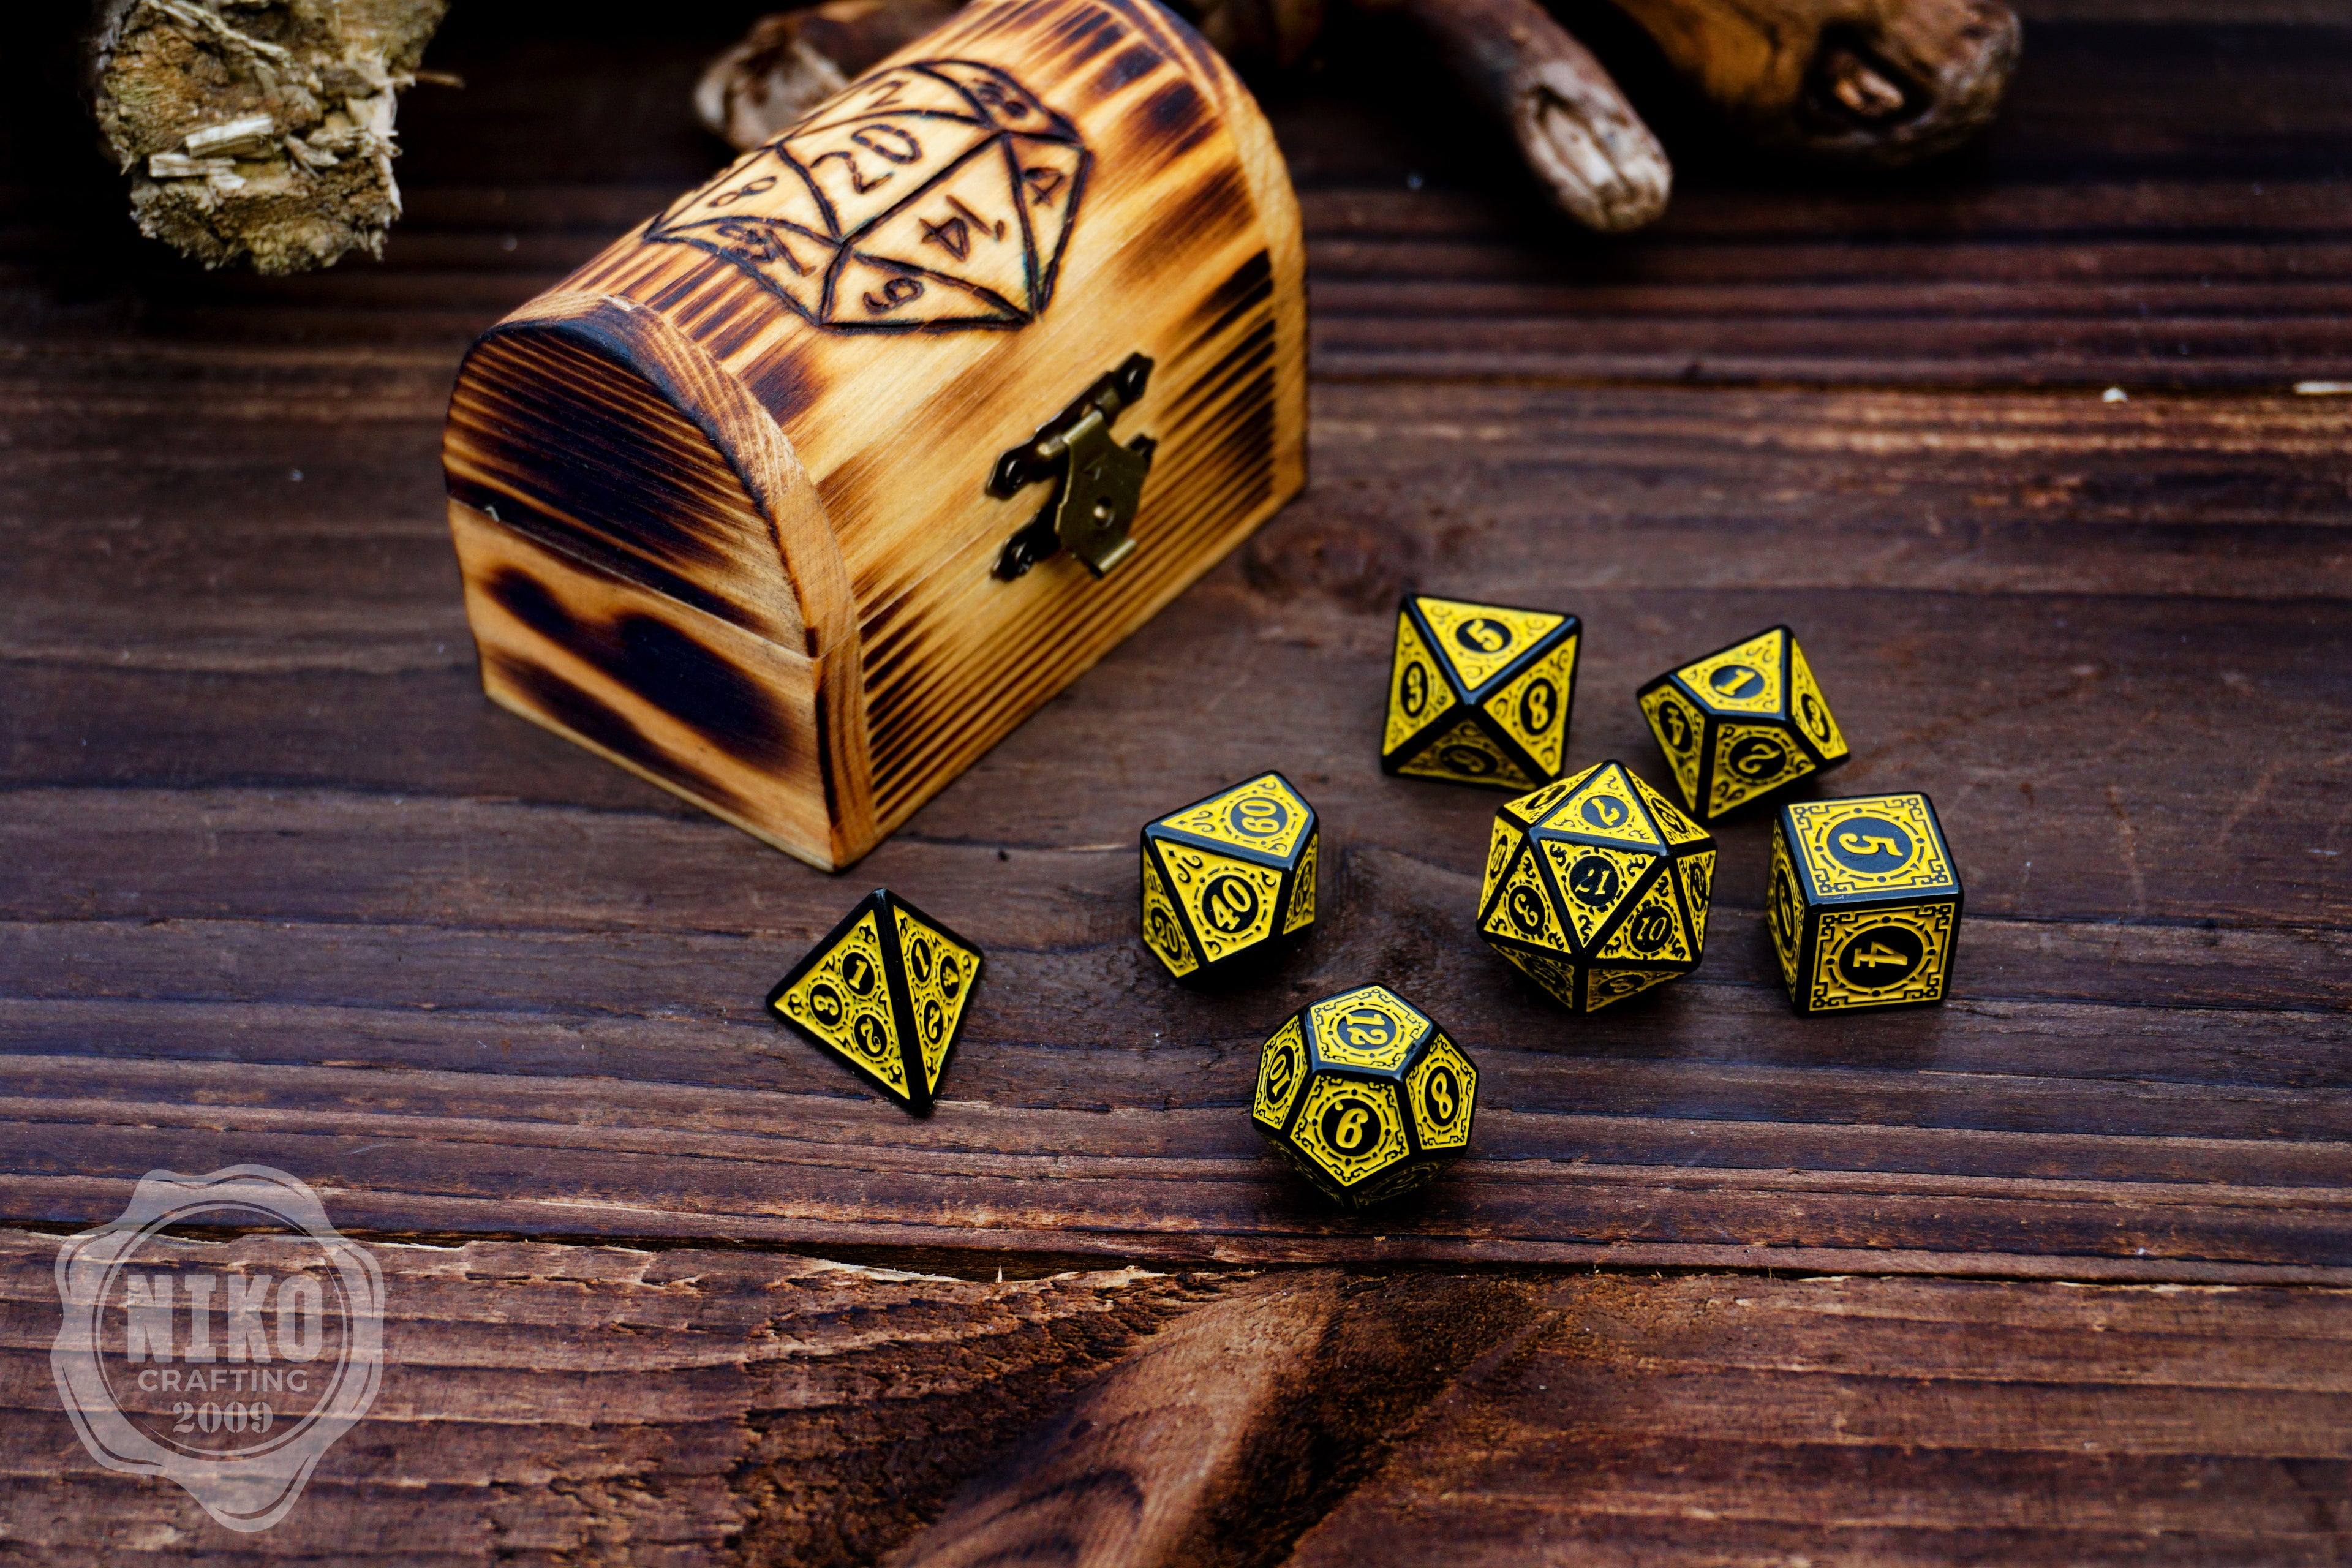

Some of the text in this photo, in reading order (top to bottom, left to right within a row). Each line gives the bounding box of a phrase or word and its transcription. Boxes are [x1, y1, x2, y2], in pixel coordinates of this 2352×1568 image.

[810, 123, 922, 194] 20
[708, 176, 777, 208] 8
[1466, 619, 1504, 652] 5
[1716, 669, 1755, 696] 1
[1529, 684, 1549, 729] 8
[1667, 707, 1684, 746] 4
[1839, 833, 1903, 856] 5
[1211, 878, 1251, 930] 40
[1514, 894, 1538, 927] 3
[1155, 916, 1178, 952] 20
[1640, 916, 1667, 941] 10
[914, 944, 929, 978] 1
[1853, 941, 1908, 968] 4
[849, 960, 867, 989] 1
[1345, 1014, 1388, 1045] 12
[1270, 1054, 1291, 1096] 10
[1431, 1072, 1453, 1119] 8
